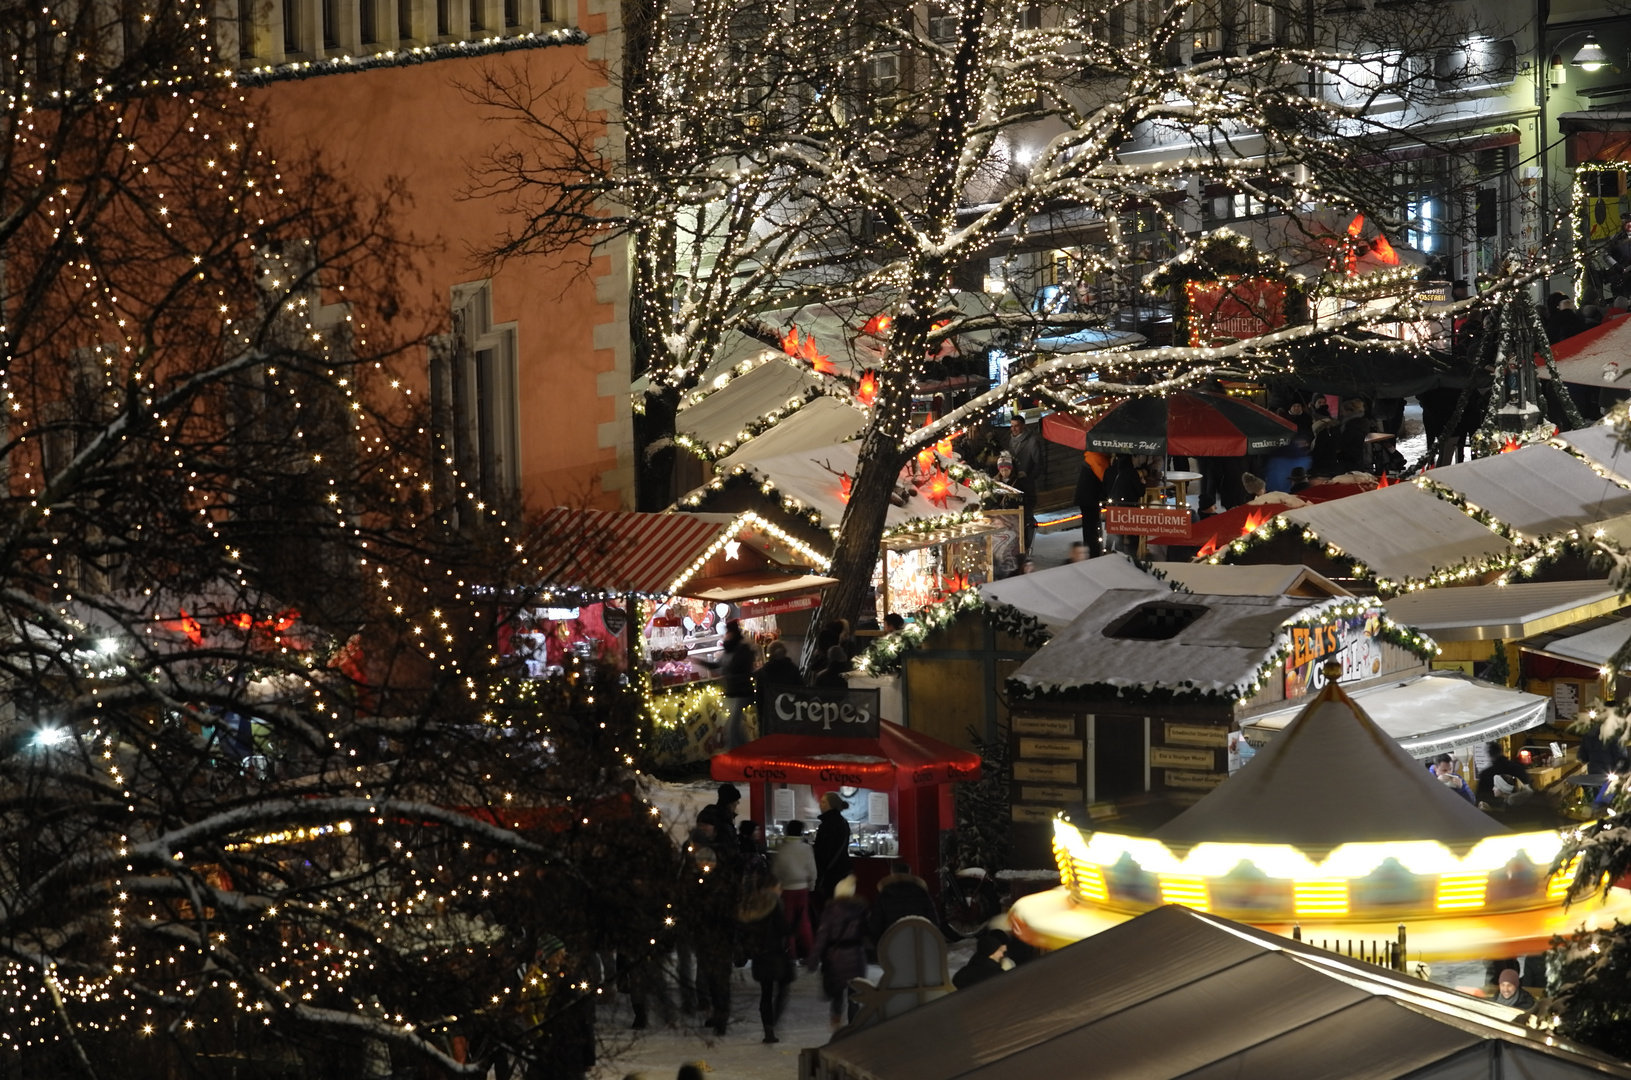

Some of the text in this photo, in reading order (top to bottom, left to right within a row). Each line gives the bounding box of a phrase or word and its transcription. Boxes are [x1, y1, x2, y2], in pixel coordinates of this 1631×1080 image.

[1292, 625, 1337, 668] ELA'S
[1313, 641, 1361, 690] GILL
[774, 692, 870, 730] Crêpes
[743, 765, 787, 780] Crêpes
[819, 768, 862, 784] Crêpes
